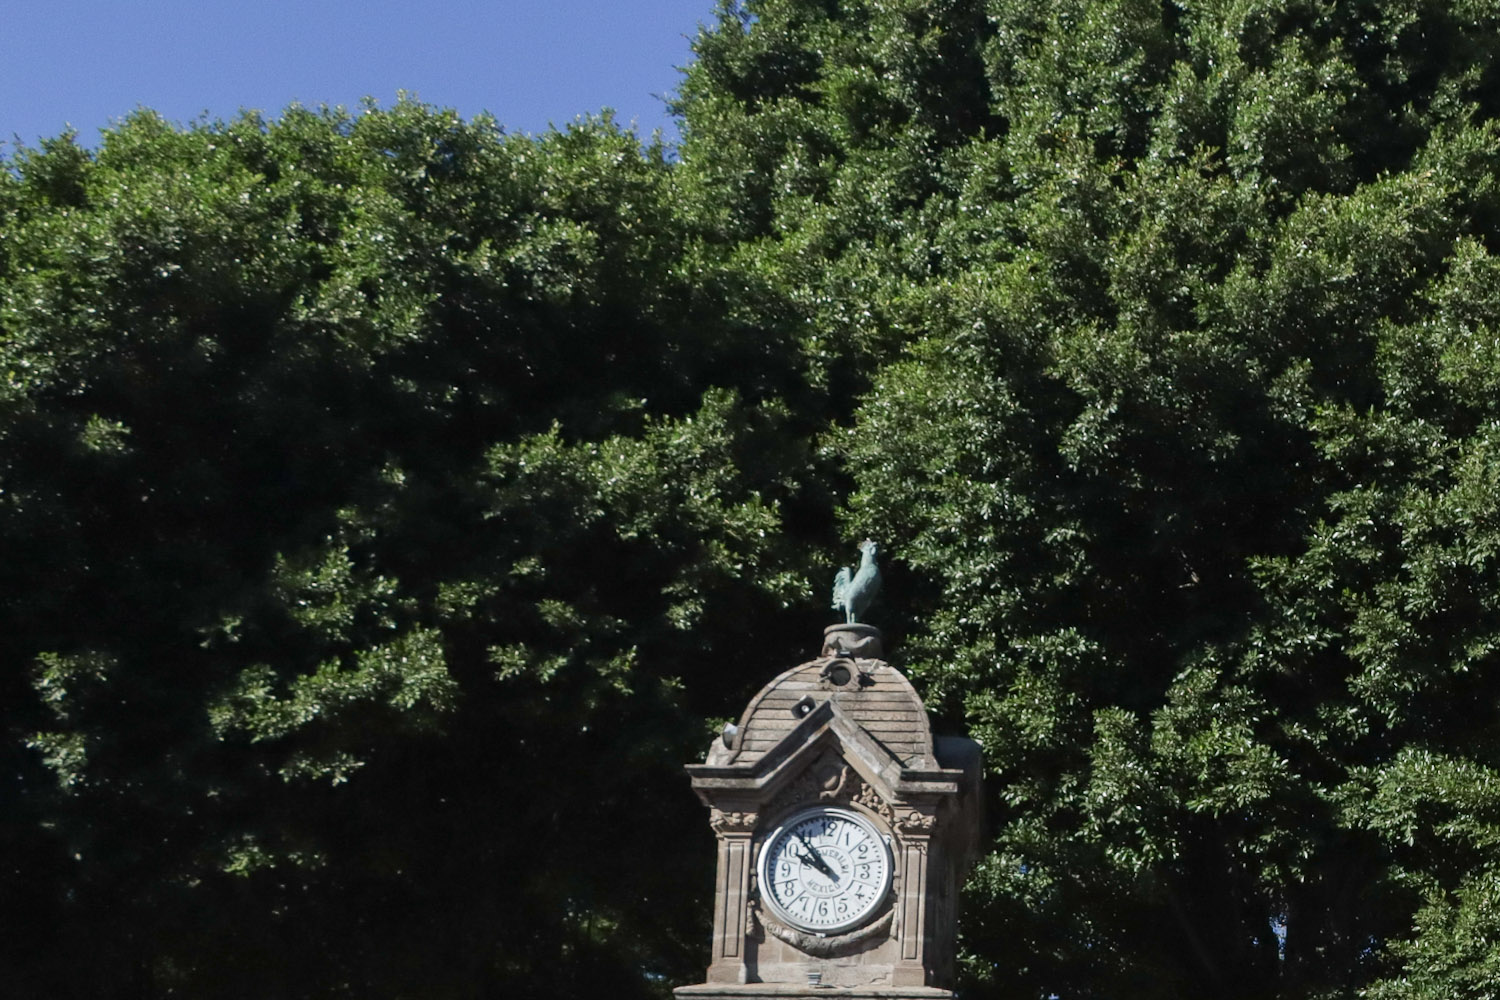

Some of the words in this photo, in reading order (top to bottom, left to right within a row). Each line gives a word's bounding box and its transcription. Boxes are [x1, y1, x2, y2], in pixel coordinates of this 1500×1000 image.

[821, 821, 838, 837] 12
[784, 844, 799, 858] 10
[858, 844, 869, 859] 2
[781, 863, 792, 878] 9
[860, 864, 870, 879] 3
[784, 881, 794, 897] 8
[855, 885, 865, 900] 4
[799, 897, 809, 911] 7
[818, 901, 828, 916] 6
[838, 898, 848, 913] 5
